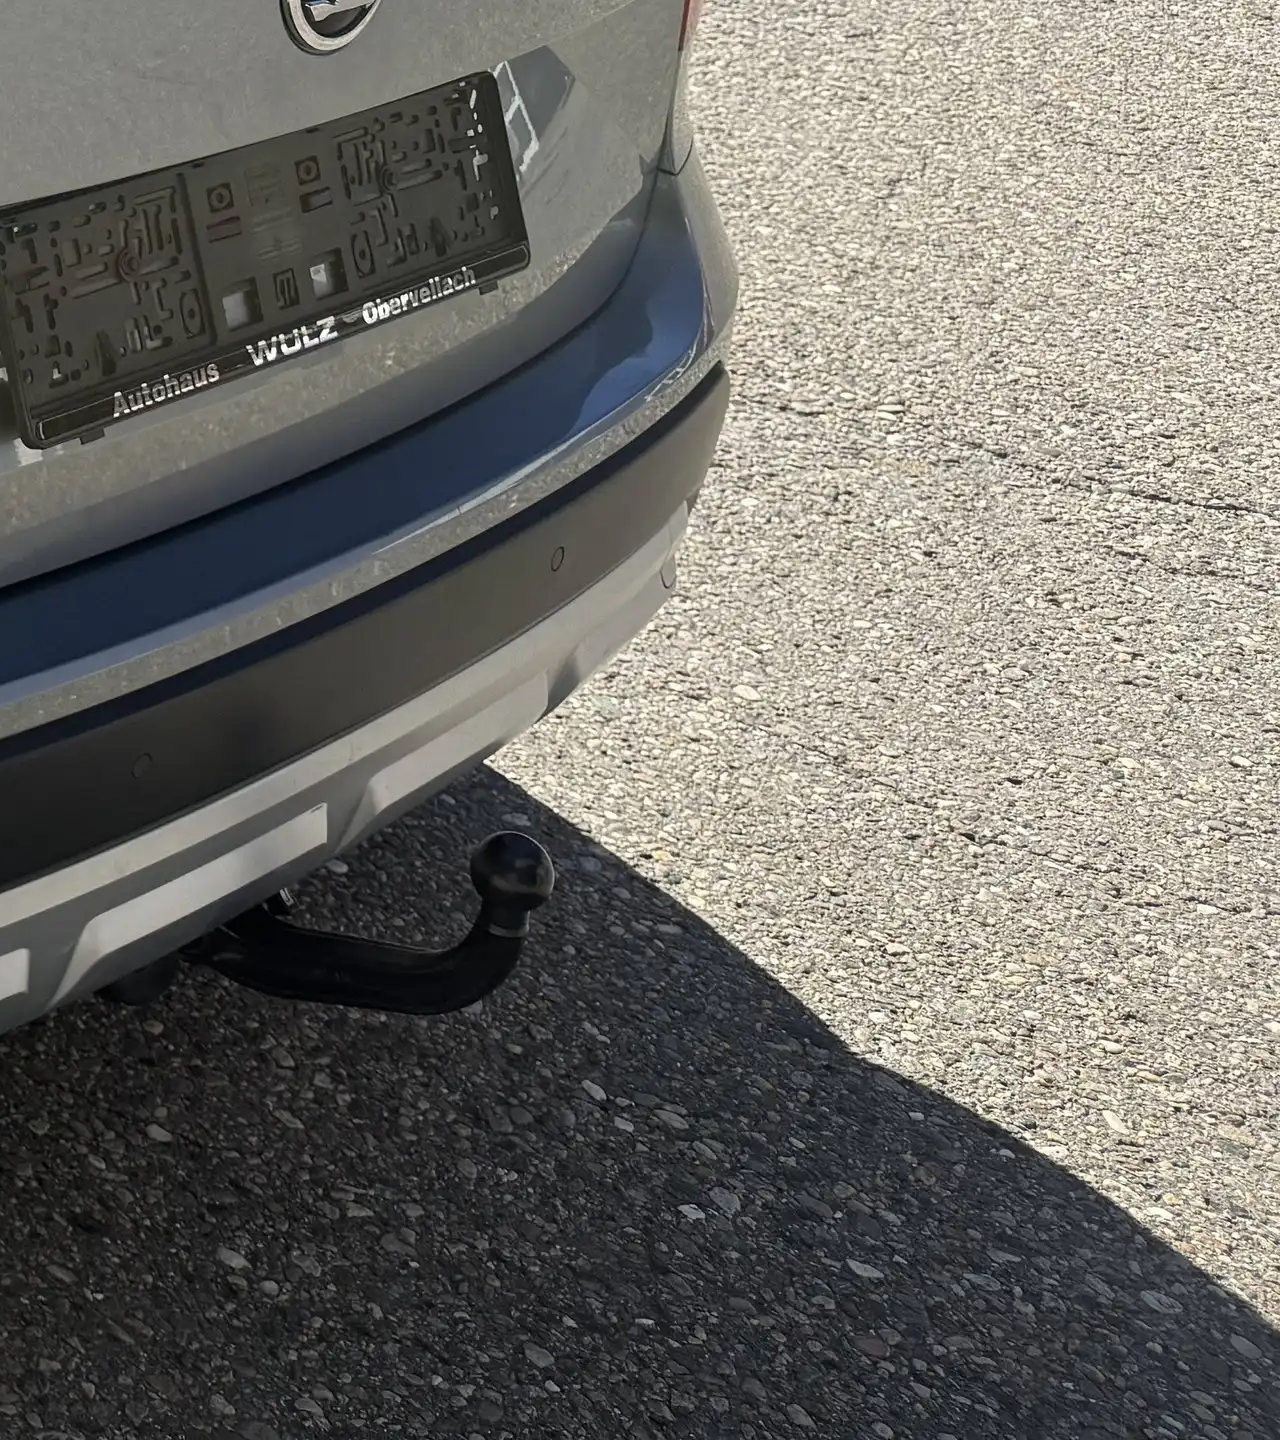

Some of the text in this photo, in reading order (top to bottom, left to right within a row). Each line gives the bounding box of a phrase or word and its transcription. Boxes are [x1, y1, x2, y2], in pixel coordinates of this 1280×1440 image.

[113, 265, 477, 418] Autohaus WULZ Obervellach
